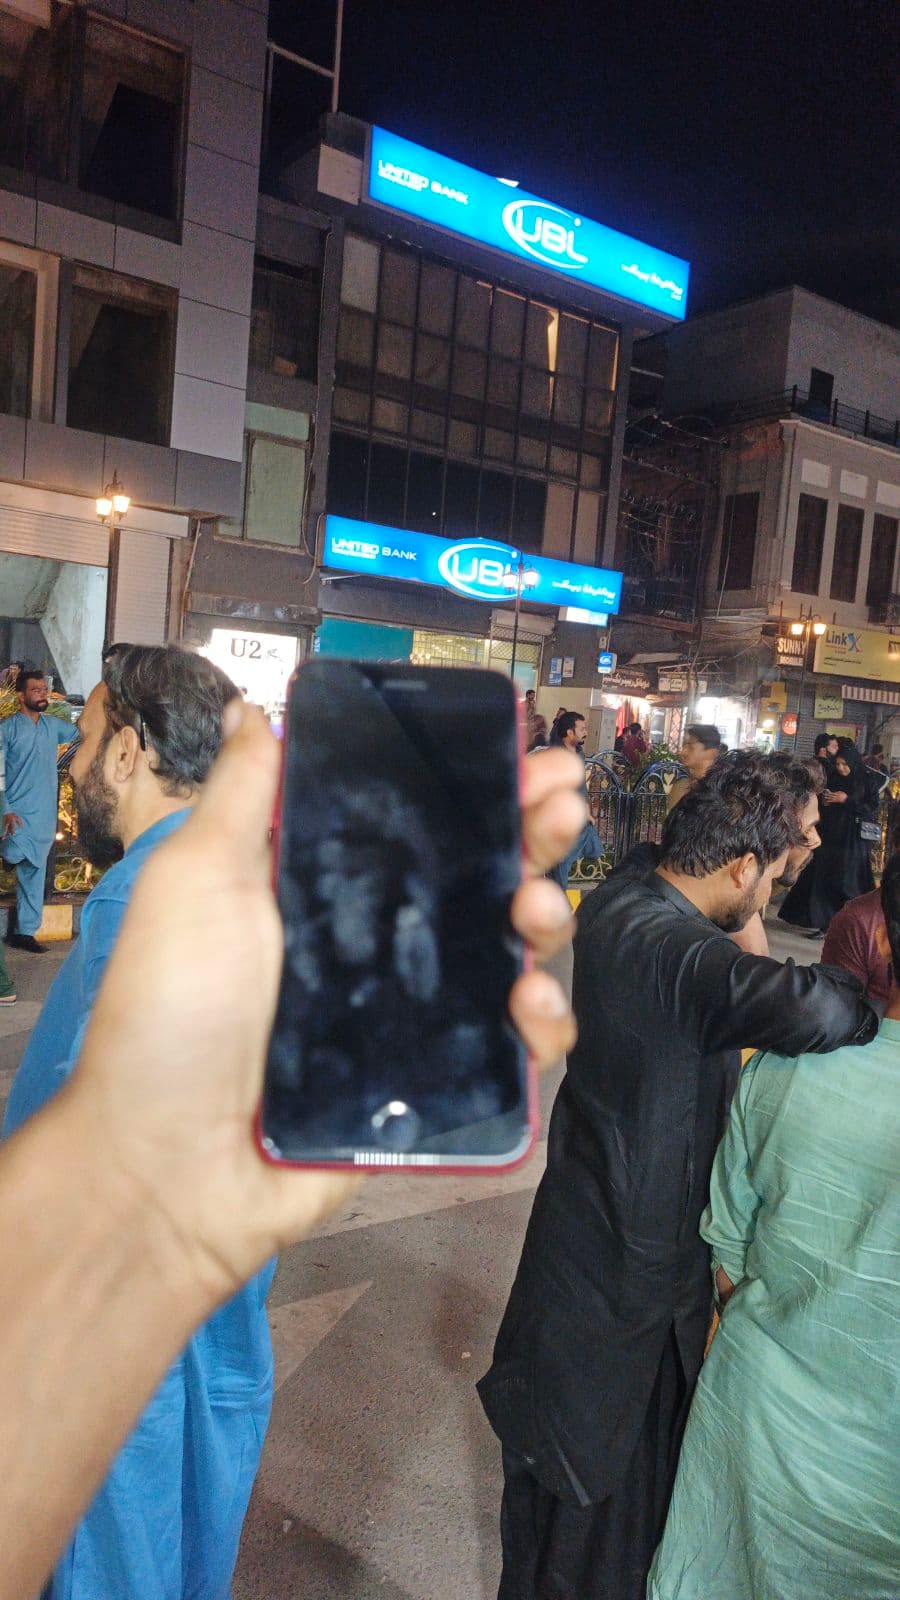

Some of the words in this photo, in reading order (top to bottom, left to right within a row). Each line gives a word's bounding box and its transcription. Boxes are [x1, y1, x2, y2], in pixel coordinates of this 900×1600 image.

[515, 208, 589, 264] UBL
[382, 546, 417, 561] BANK
[231, 638, 262, 660] U2
[777, 637, 807, 656] SUNNY
